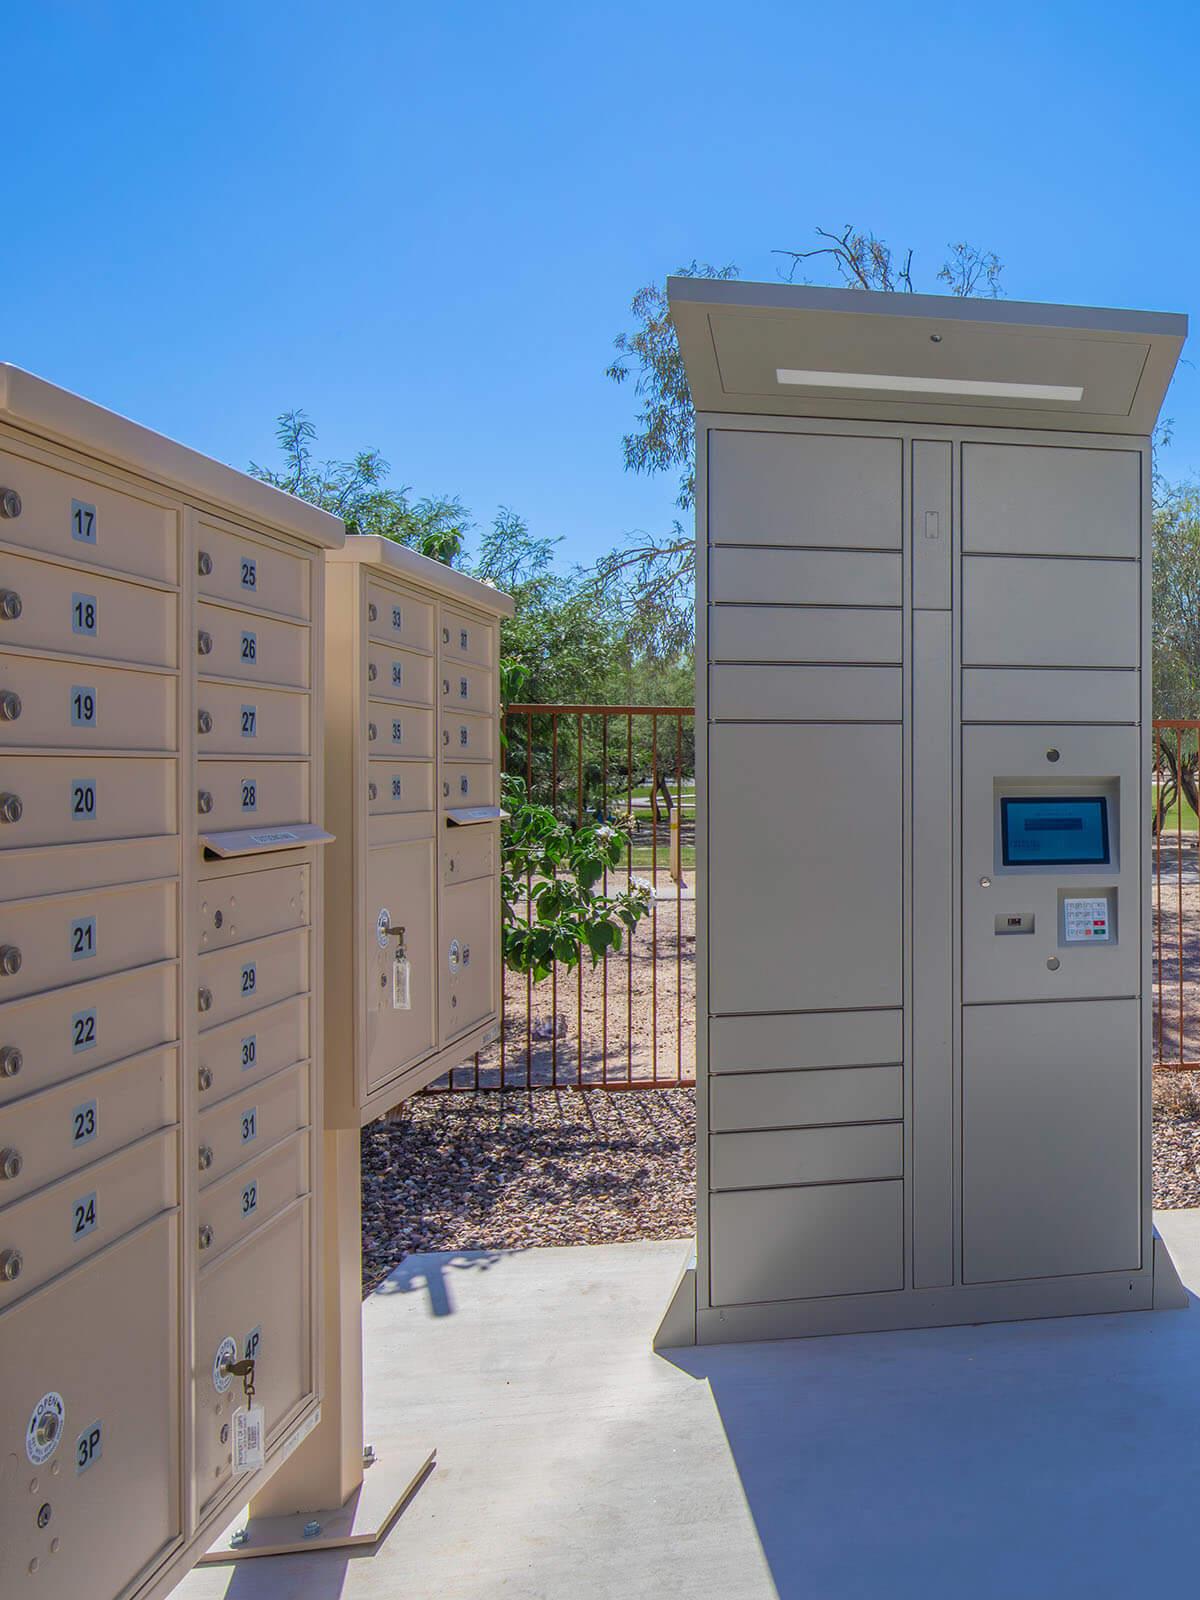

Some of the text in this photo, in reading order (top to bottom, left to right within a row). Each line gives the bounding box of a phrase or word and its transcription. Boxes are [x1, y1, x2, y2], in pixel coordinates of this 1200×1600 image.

[74, 509, 95, 537] 17
[242, 563, 256, 586] 25
[75, 601, 95, 630] 18
[242, 637, 256, 659] 26
[391, 666, 400, 684] 34
[74, 693, 94, 722] 19
[242, 710, 256, 732] 27
[391, 723, 401, 742] 35
[74, 786, 95, 814] 20
[242, 786, 256, 807] 28
[74, 924, 93, 953] 21
[242, 969, 255, 992] 29
[74, 1016, 95, 1046] 22
[242, 1041, 256, 1066] 30
[74, 1109, 95, 1140] 23
[242, 1116, 255, 1140] 31
[242, 1189, 256, 1213] 32
[74, 1200, 95, 1234] 24
[244, 1332, 260, 1360] 4P
[78, 1429, 100, 1468] 3P
